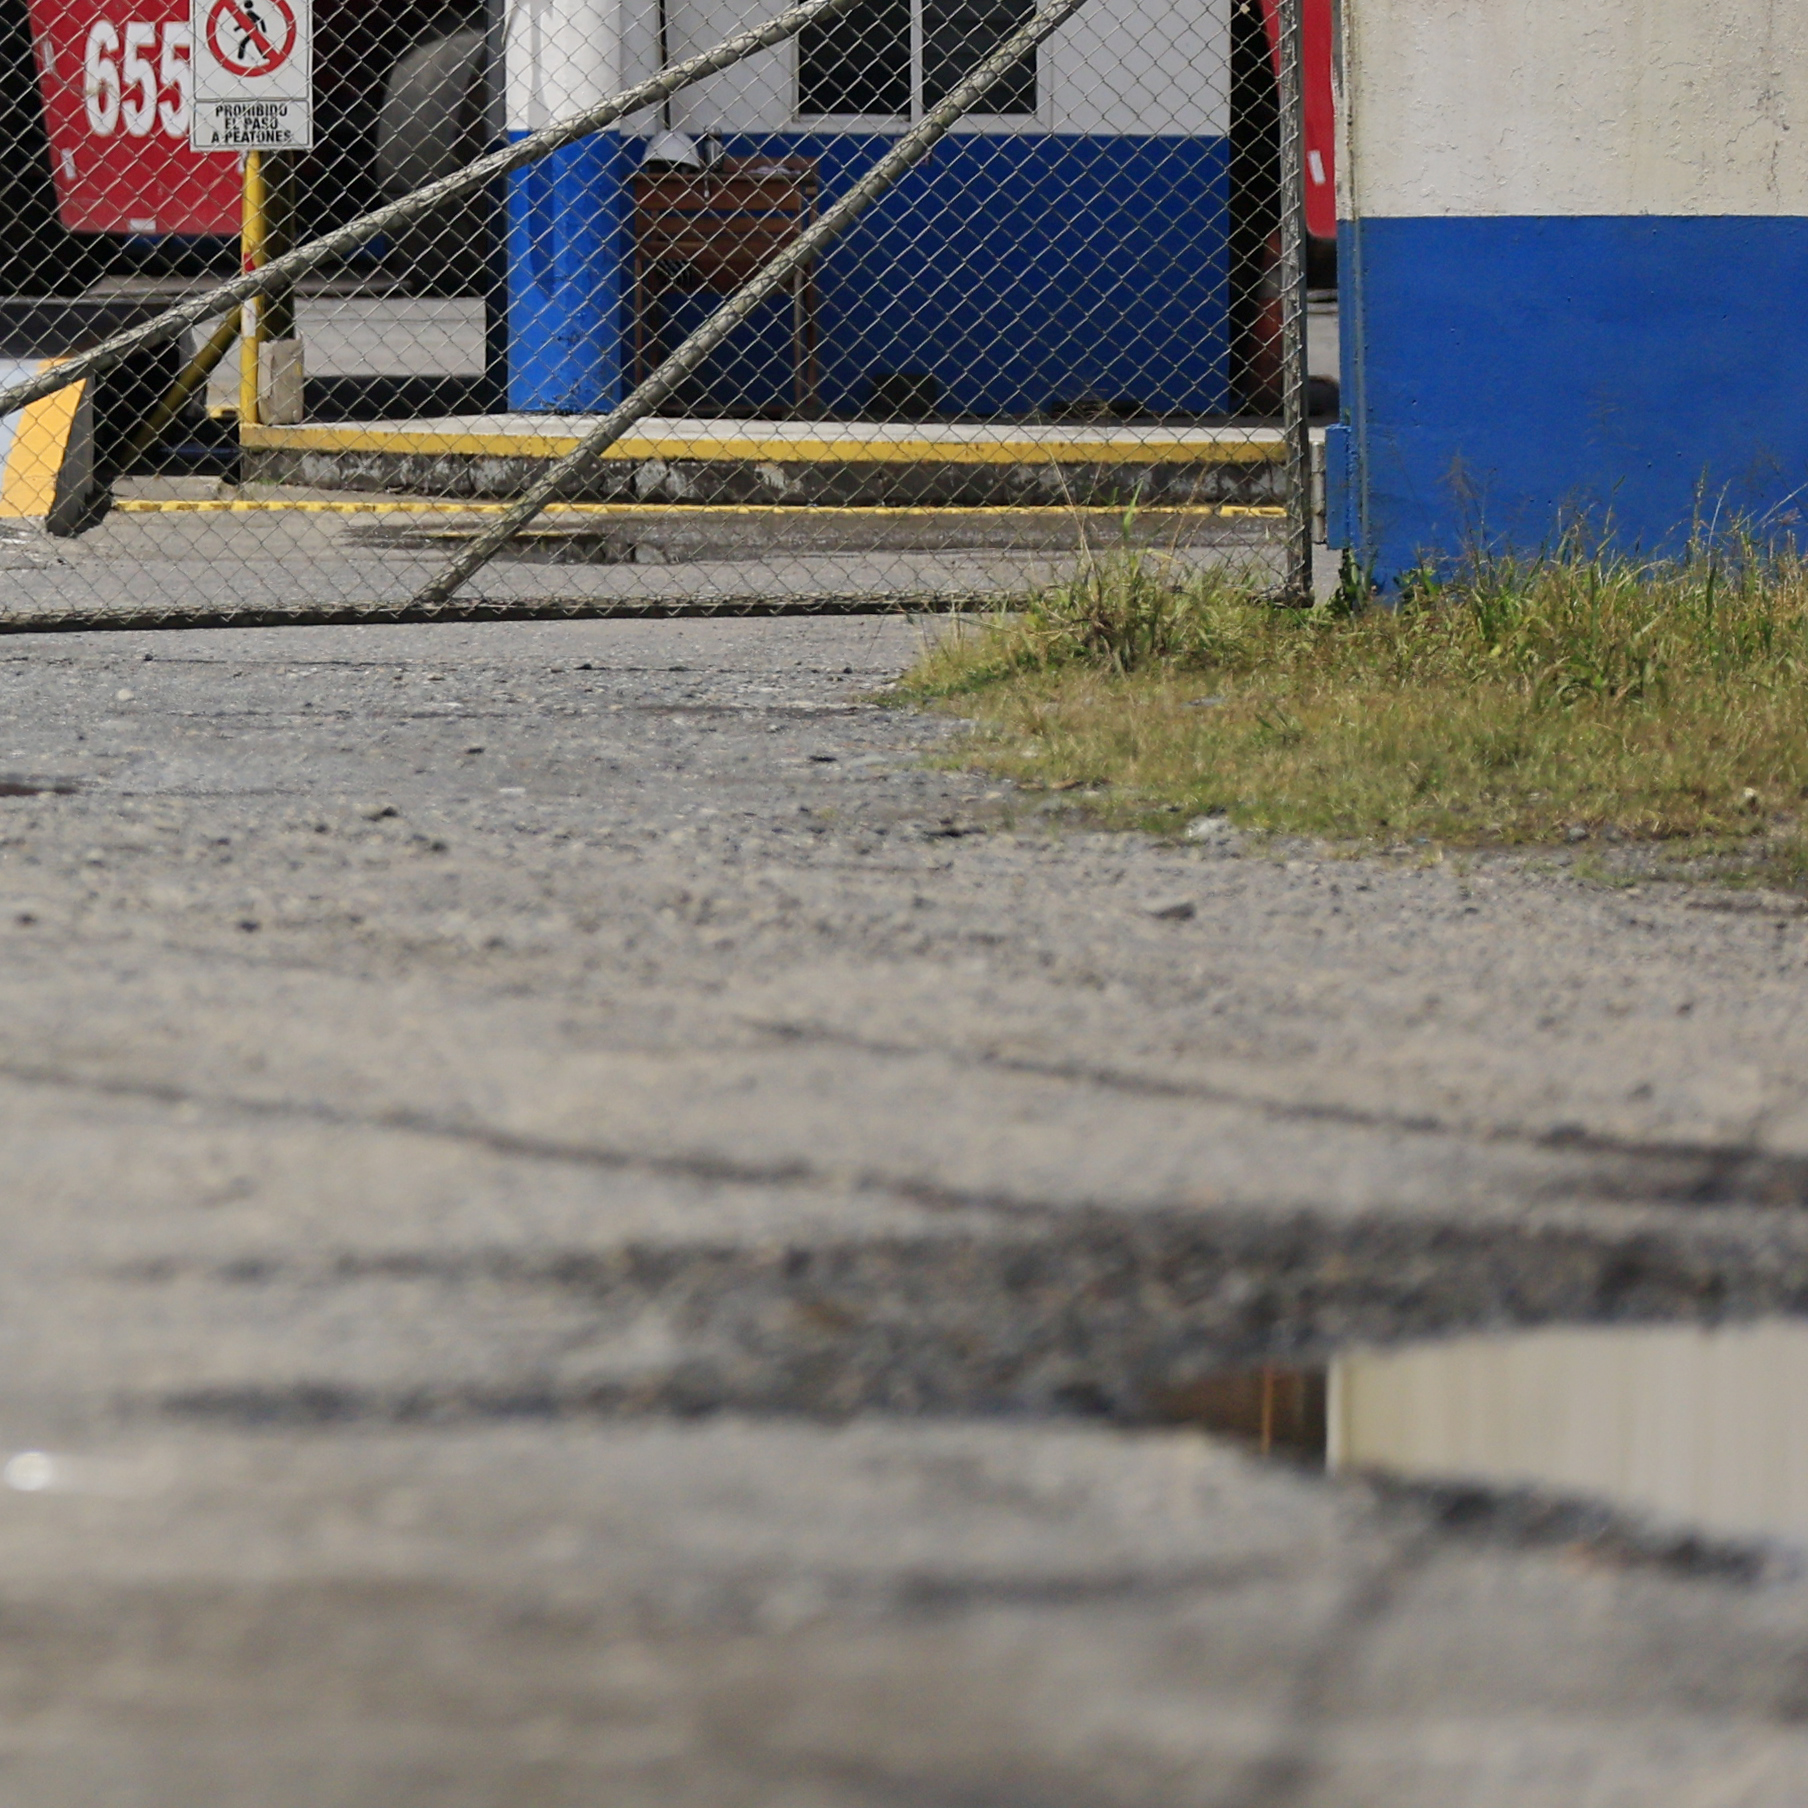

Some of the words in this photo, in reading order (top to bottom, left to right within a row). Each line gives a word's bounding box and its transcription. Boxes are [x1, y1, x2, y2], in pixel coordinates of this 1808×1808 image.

[85, 19, 191, 137] 655
[215, 103, 288, 117] PROHIBIDO
[245, 116, 278, 130] PASO
[211, 131, 221, 143] A
[225, 129, 292, 143] PEATONES
